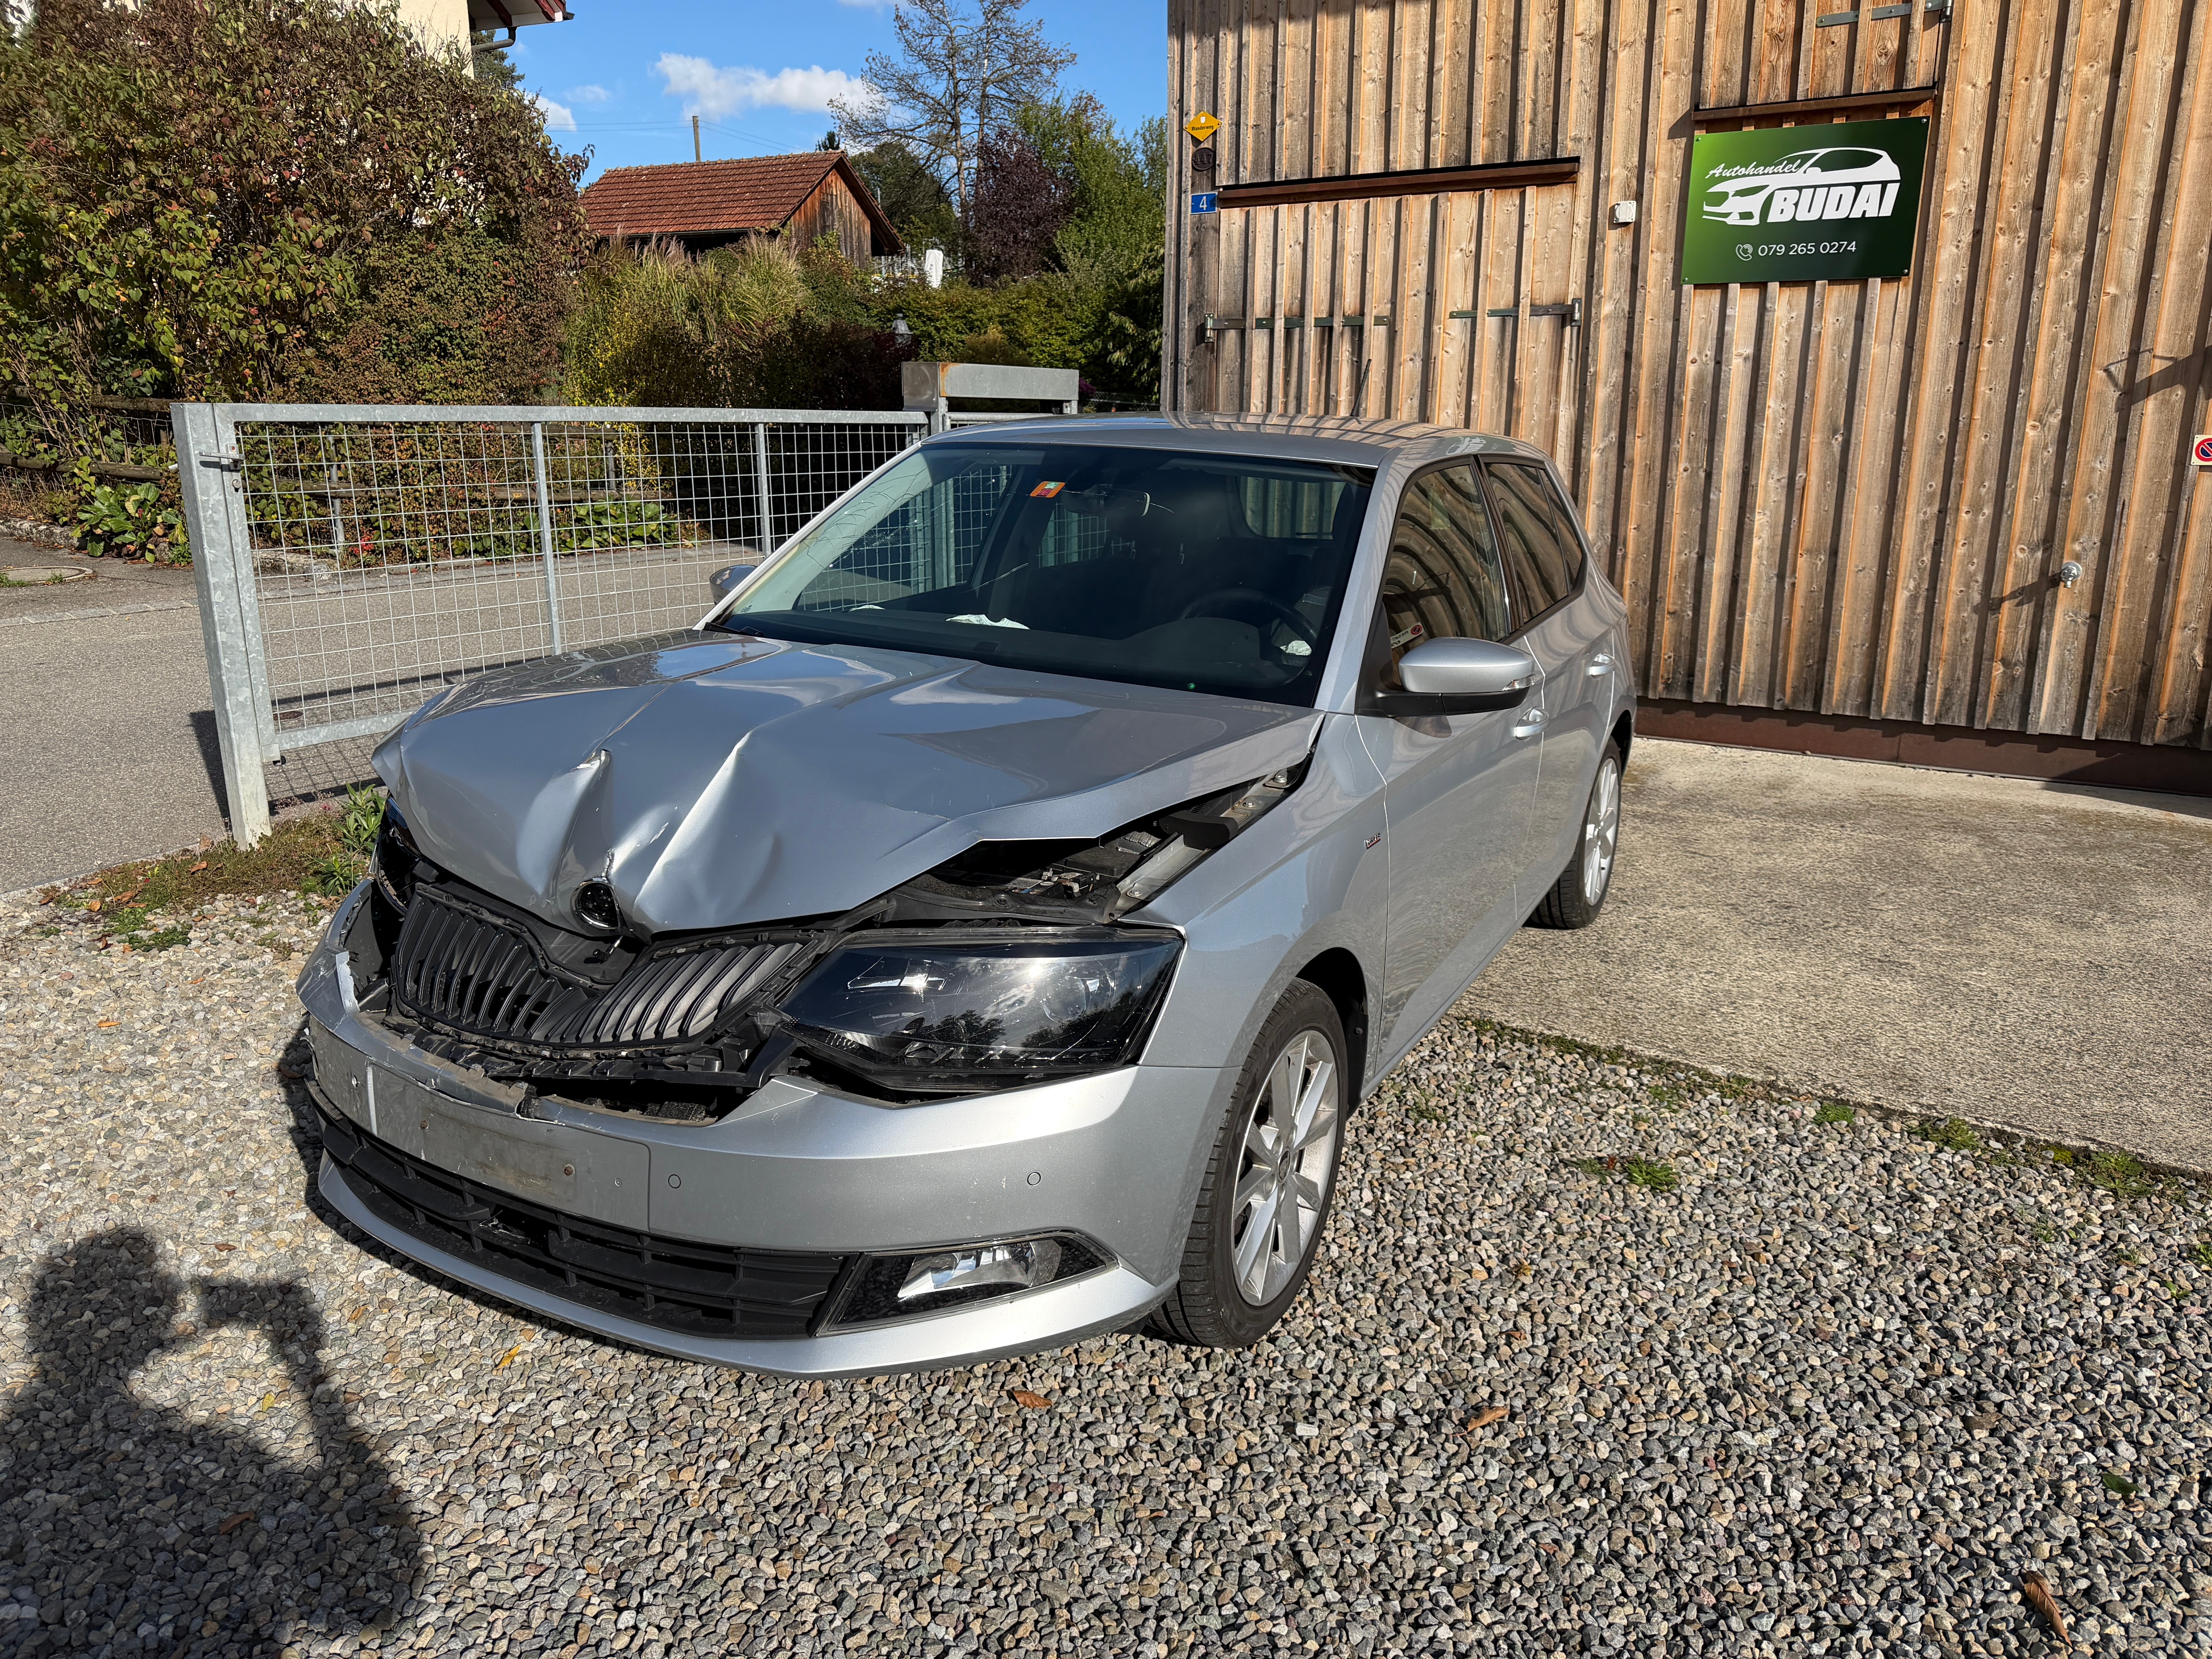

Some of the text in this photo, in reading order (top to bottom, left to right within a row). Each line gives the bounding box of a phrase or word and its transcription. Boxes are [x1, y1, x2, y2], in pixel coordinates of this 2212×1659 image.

[1705, 159, 1802, 179] Autohandel
[1199, 196, 1207, 211] 4
[1767, 182, 1900, 223] BUDAI
[1758, 241, 1856, 256] 079 265 0274
